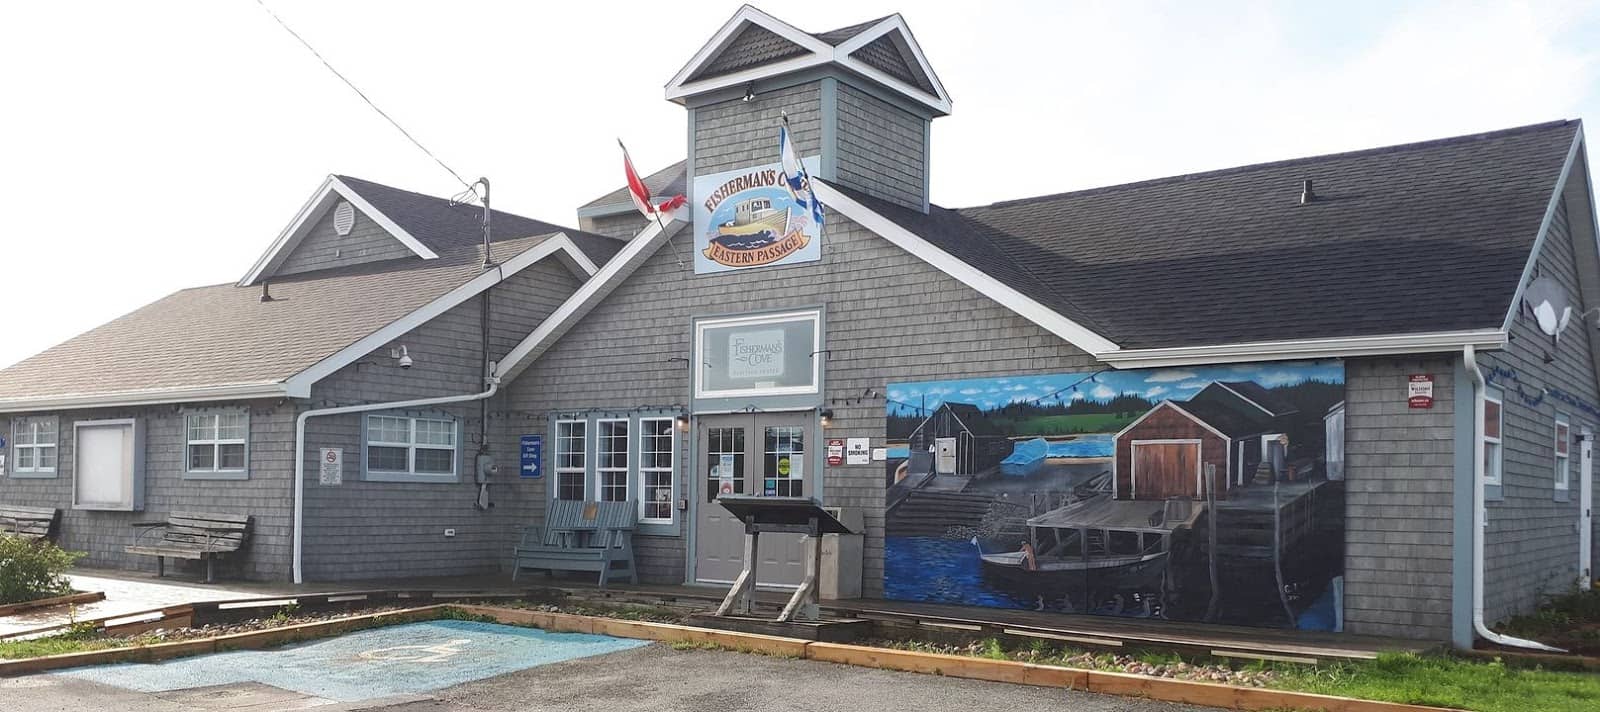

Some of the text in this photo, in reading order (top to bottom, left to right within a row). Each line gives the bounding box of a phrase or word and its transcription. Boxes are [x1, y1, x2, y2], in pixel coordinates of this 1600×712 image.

[704, 168, 776, 213] FISHERMAN'S
[713, 235, 799, 264] EASTERN PASSAGE
[748, 353, 773, 366] COVE
